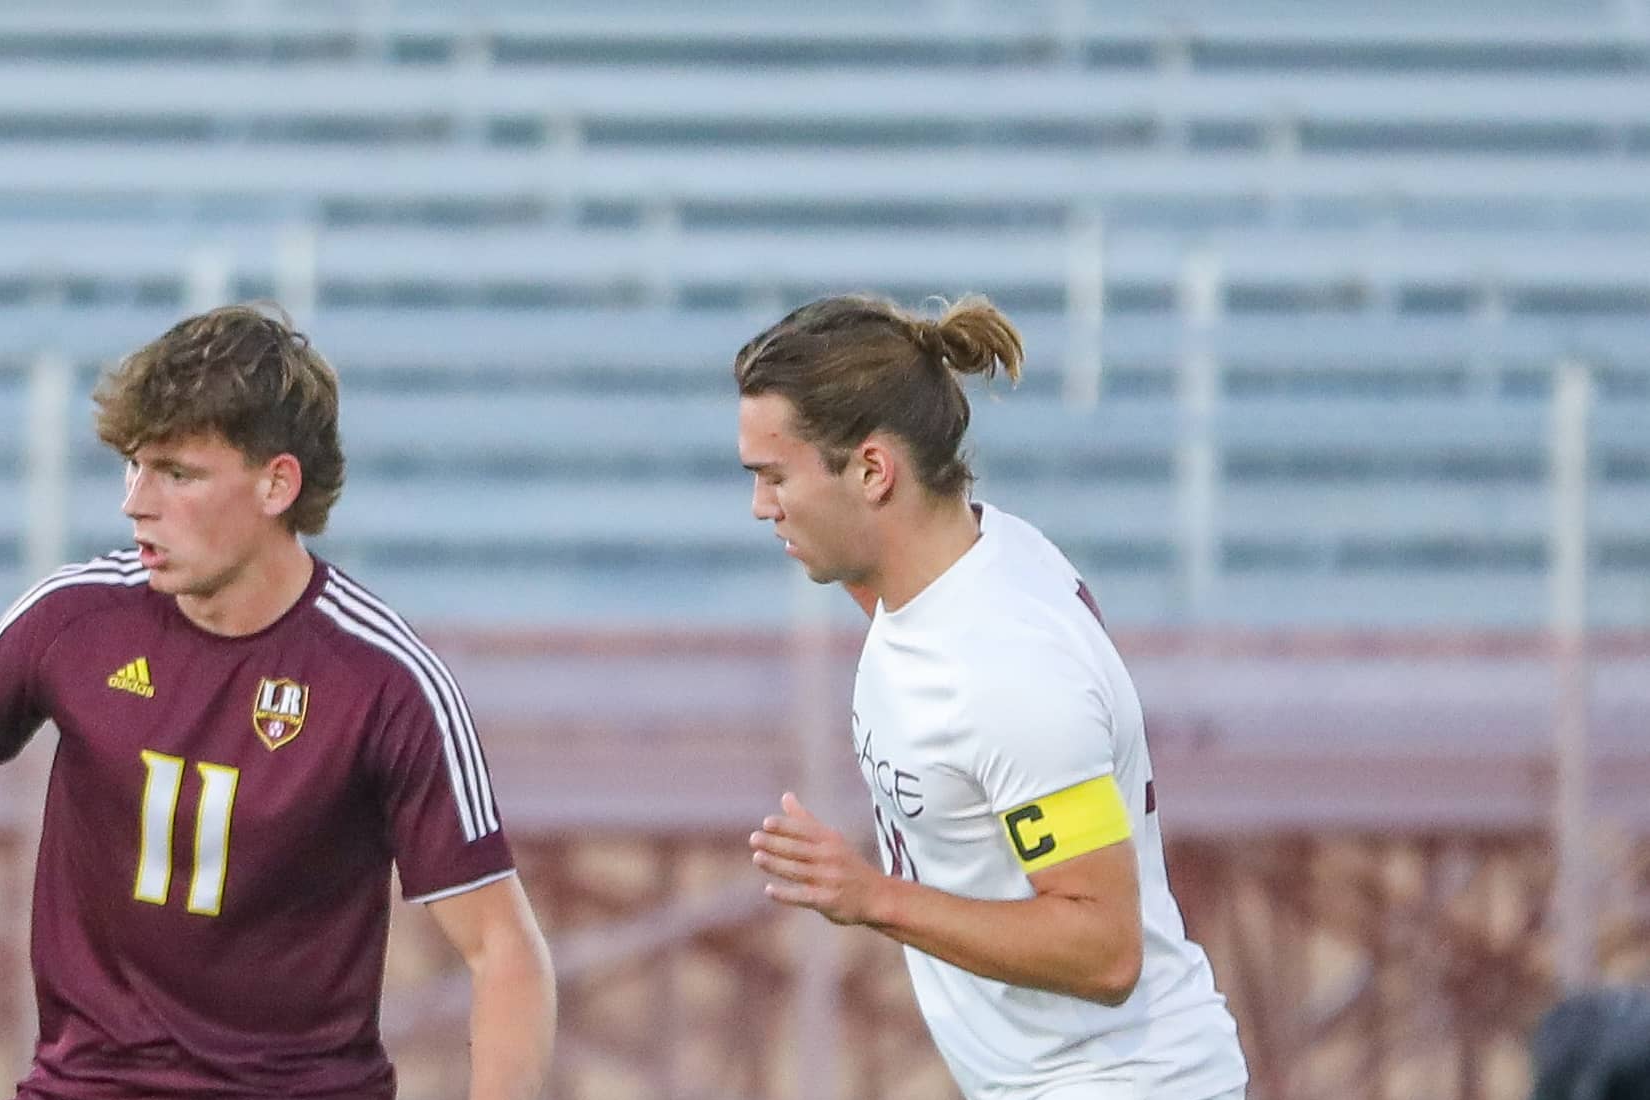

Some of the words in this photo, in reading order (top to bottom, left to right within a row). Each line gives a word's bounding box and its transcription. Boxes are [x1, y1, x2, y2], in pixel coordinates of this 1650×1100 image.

[108, 675, 155, 698] adidas
[258, 680, 303, 716] LR
[134, 749, 240, 917] 11
[1005, 804, 1056, 862] C
